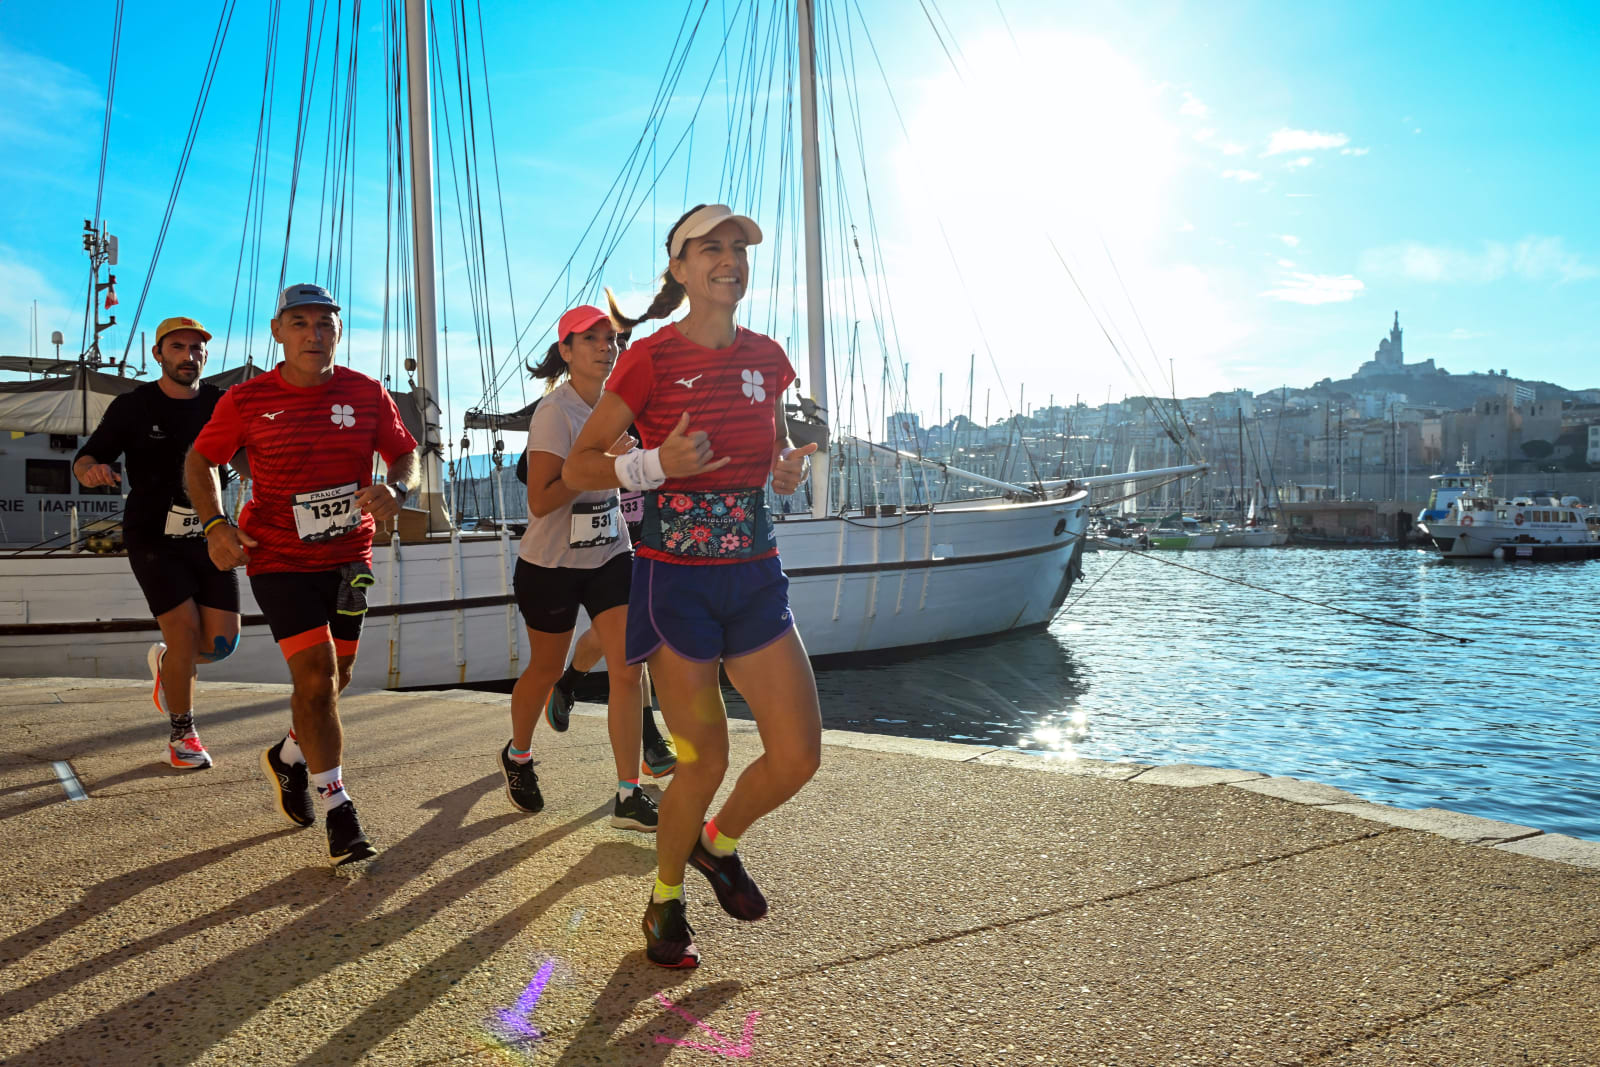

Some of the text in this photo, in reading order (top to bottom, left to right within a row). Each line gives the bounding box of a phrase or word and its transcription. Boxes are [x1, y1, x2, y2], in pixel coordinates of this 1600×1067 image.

[310, 489, 342, 500] FRANCK
[39, 501, 119, 512] MARITIME
[311, 499, 350, 519] 1327
